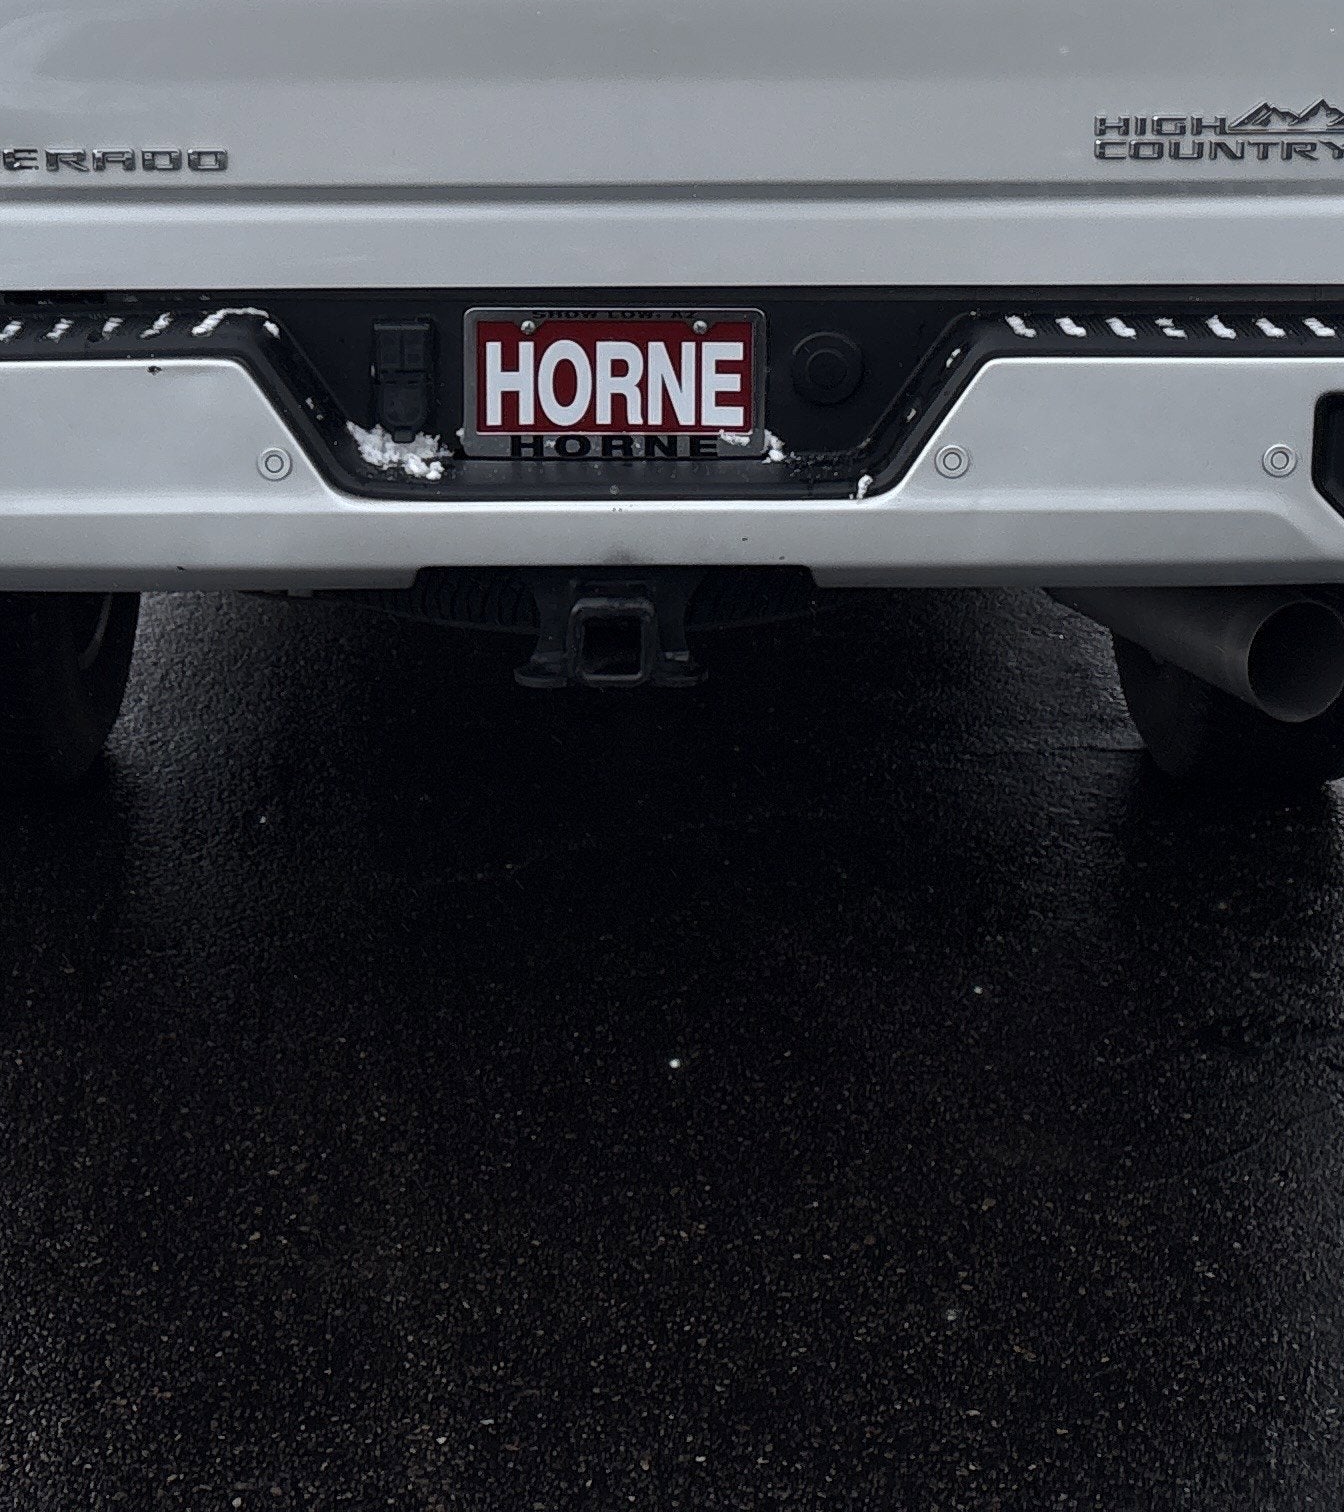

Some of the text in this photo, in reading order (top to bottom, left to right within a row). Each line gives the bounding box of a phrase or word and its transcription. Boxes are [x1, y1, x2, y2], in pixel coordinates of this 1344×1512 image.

[1093, 115, 1230, 136] HIGH
[485, 339, 744, 426] HORNE
[511, 434, 718, 457] HORNE
